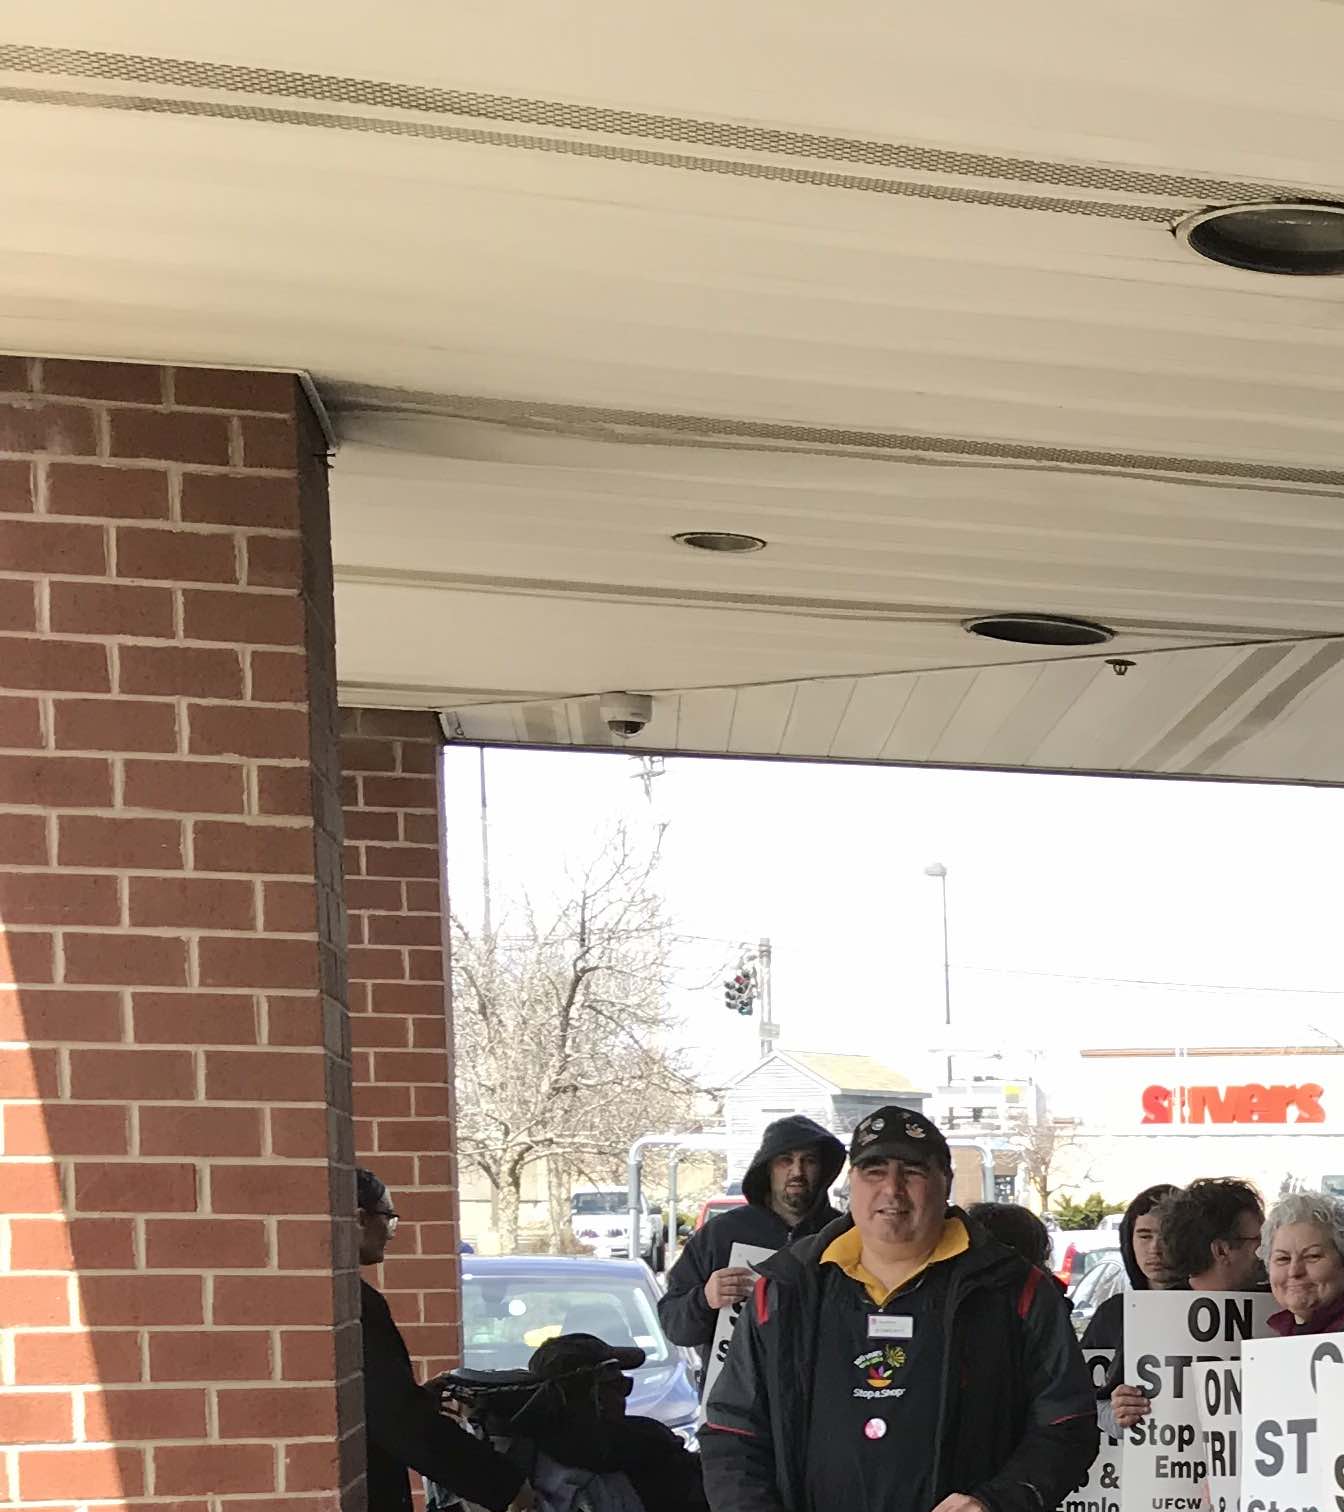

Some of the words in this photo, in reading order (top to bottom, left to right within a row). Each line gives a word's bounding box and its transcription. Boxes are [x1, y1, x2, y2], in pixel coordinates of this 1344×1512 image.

[1188, 1298, 1254, 1342] ON
[1130, 1418, 1195, 1452] Stop
[1100, 1463, 1120, 1489] &
[1153, 1498, 1202, 1509] UFCW
